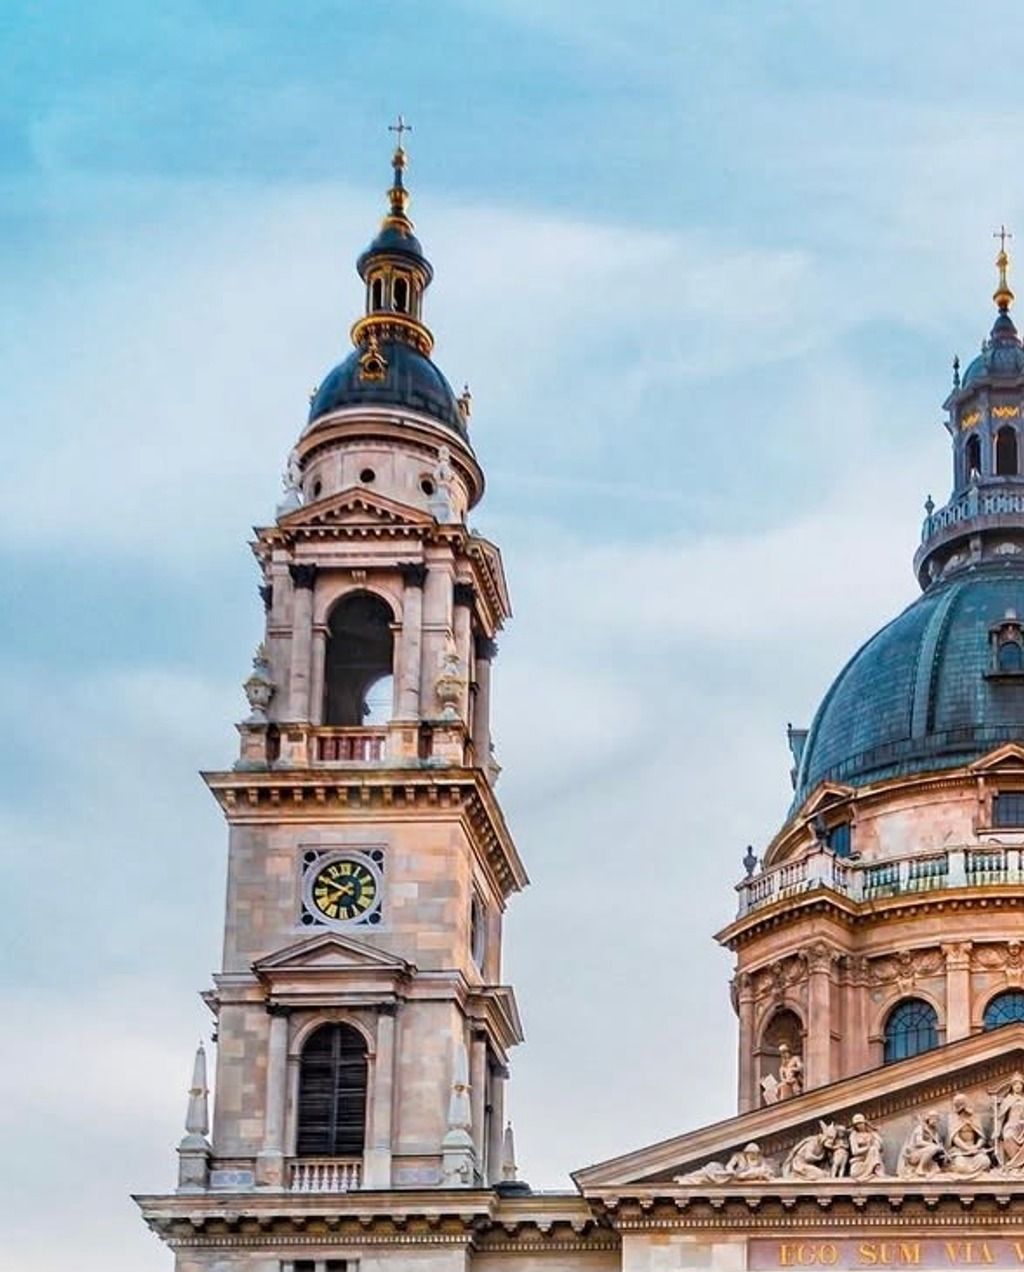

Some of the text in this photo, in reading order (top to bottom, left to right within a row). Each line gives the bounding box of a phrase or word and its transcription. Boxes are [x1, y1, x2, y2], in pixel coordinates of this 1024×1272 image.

[779, 1243, 838, 1267] EGO
[858, 1242, 921, 1265] SUM
[945, 1242, 995, 1265] VIA
